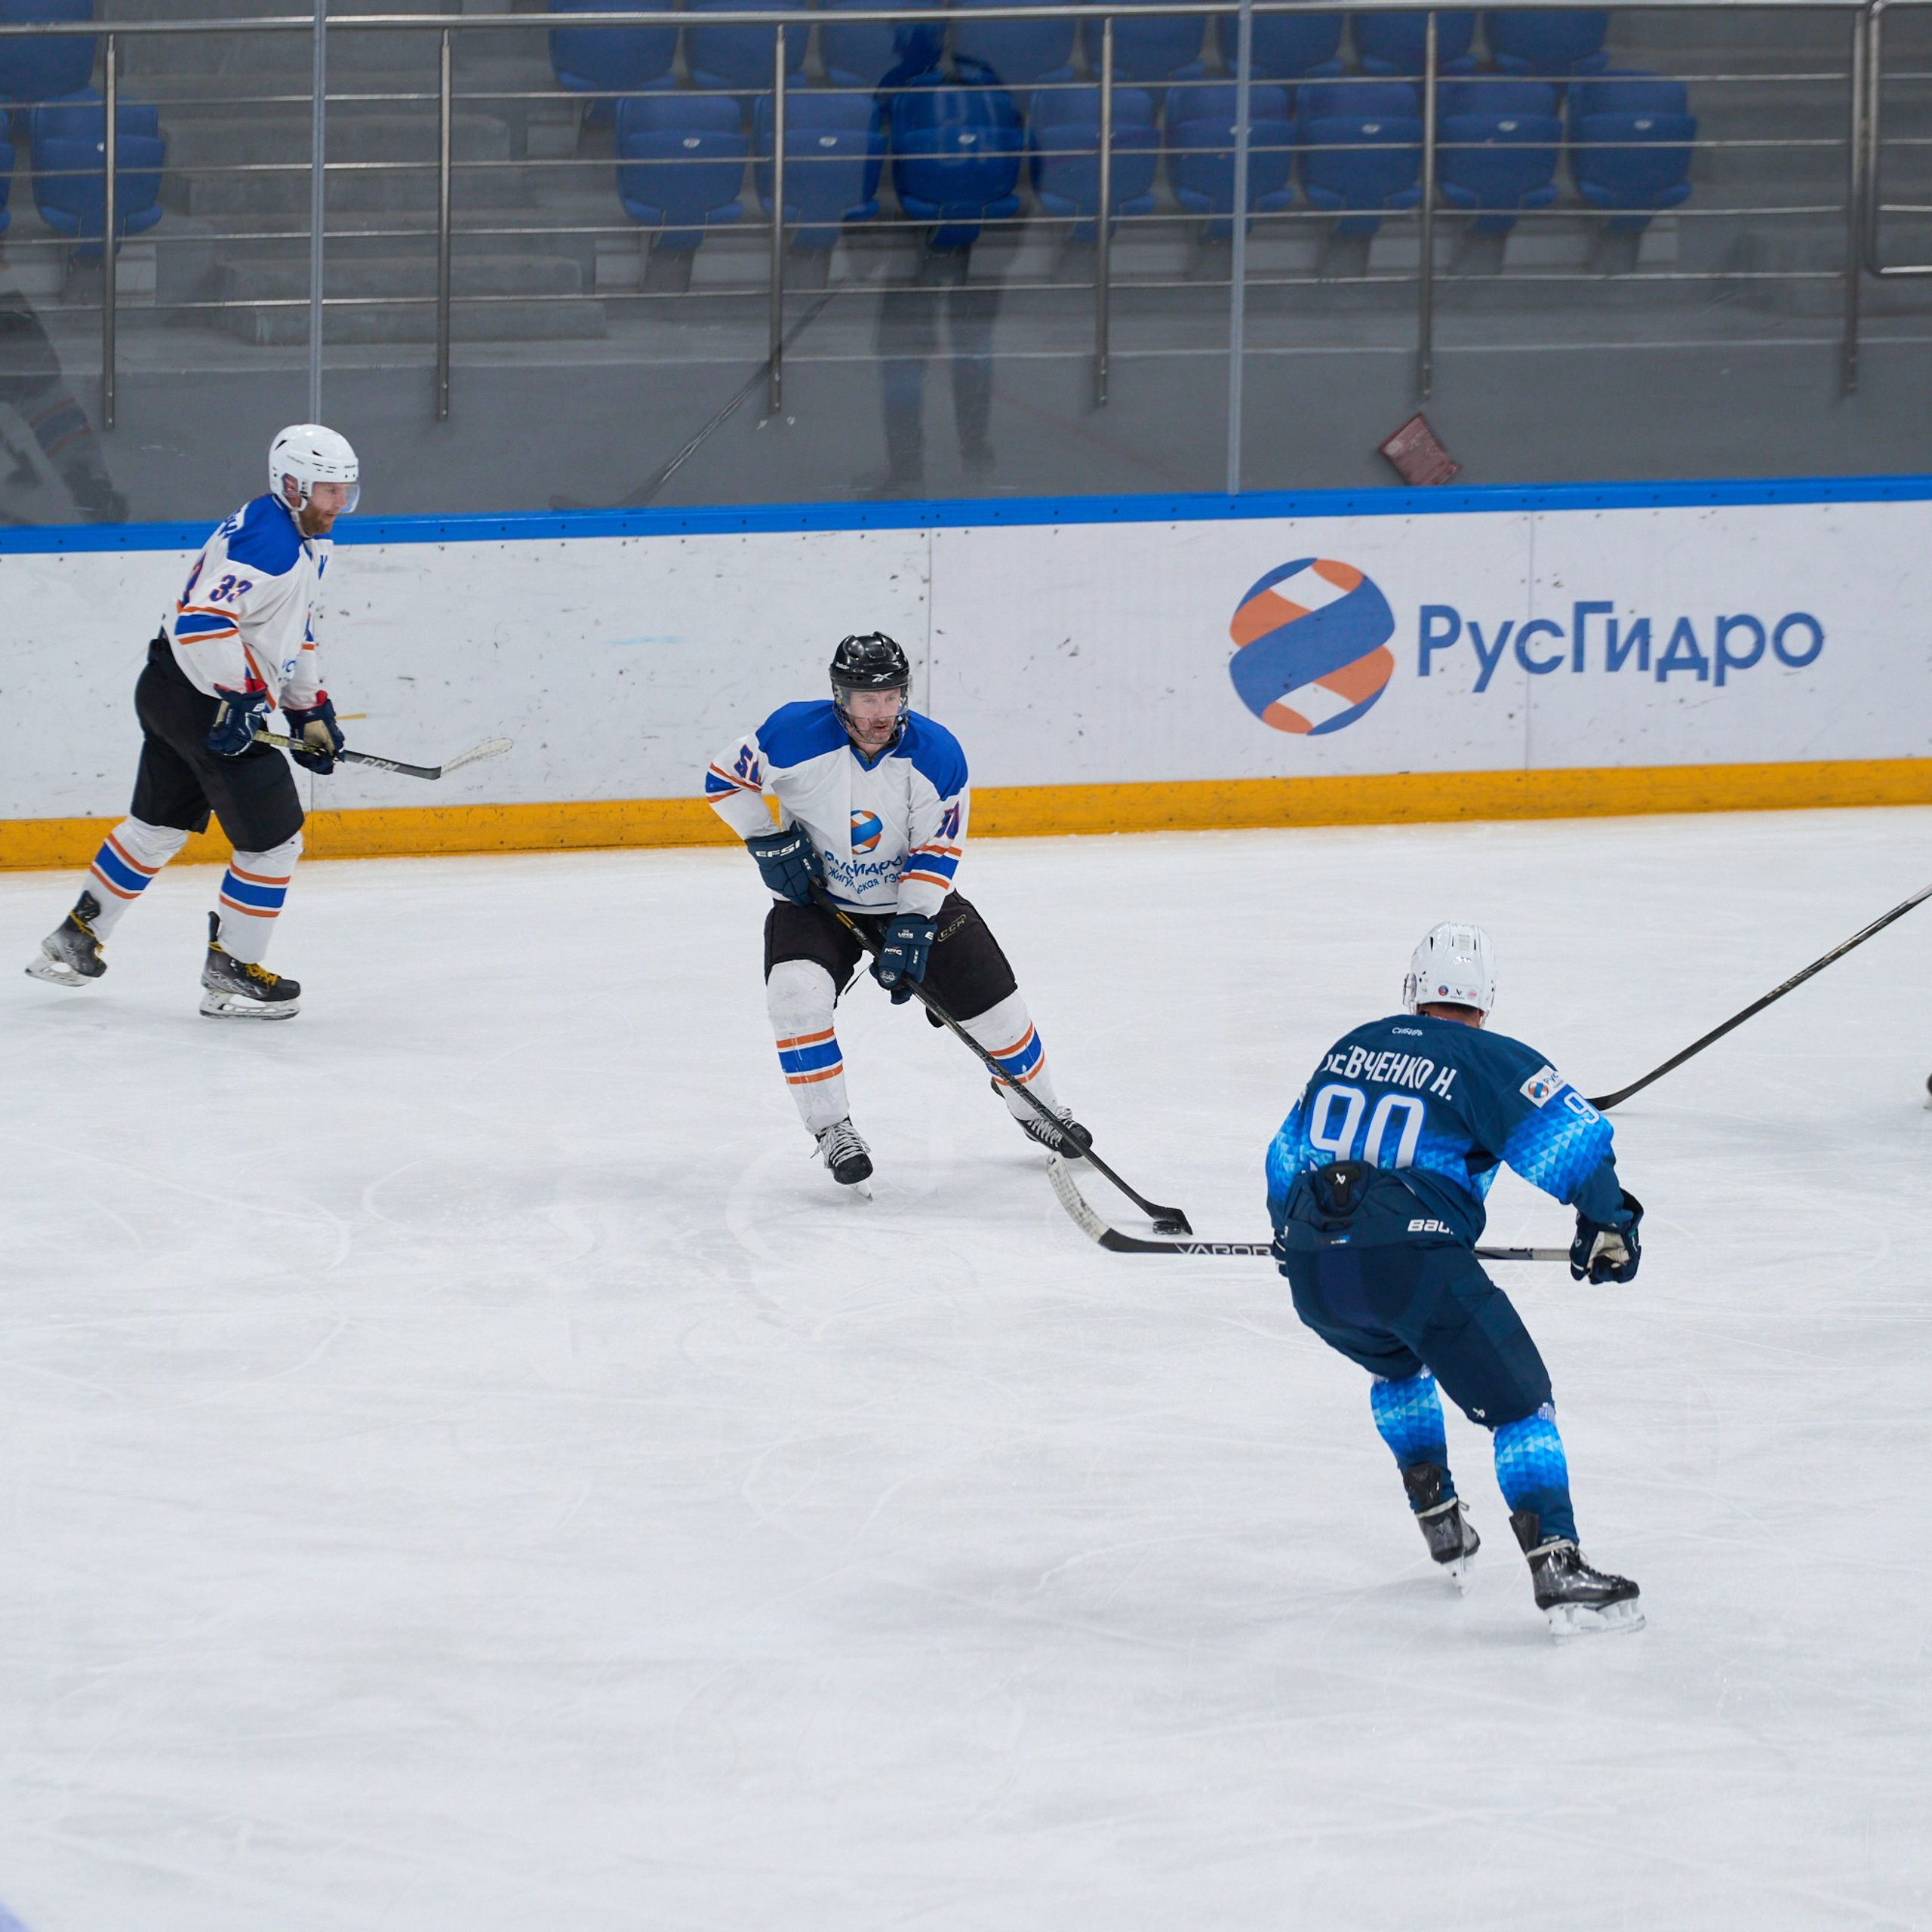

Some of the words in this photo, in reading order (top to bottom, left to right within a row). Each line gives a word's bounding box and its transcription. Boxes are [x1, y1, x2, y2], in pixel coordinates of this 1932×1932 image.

[1417, 601, 1824, 693] РусГидро
[361, 757, 400, 771] CCM
[755, 839, 800, 858] EFSI
[1429, 1066, 1457, 1101] Н.
[1309, 1082, 1426, 1171] 90
[1175, 1243, 1272, 1255] VAPOR
